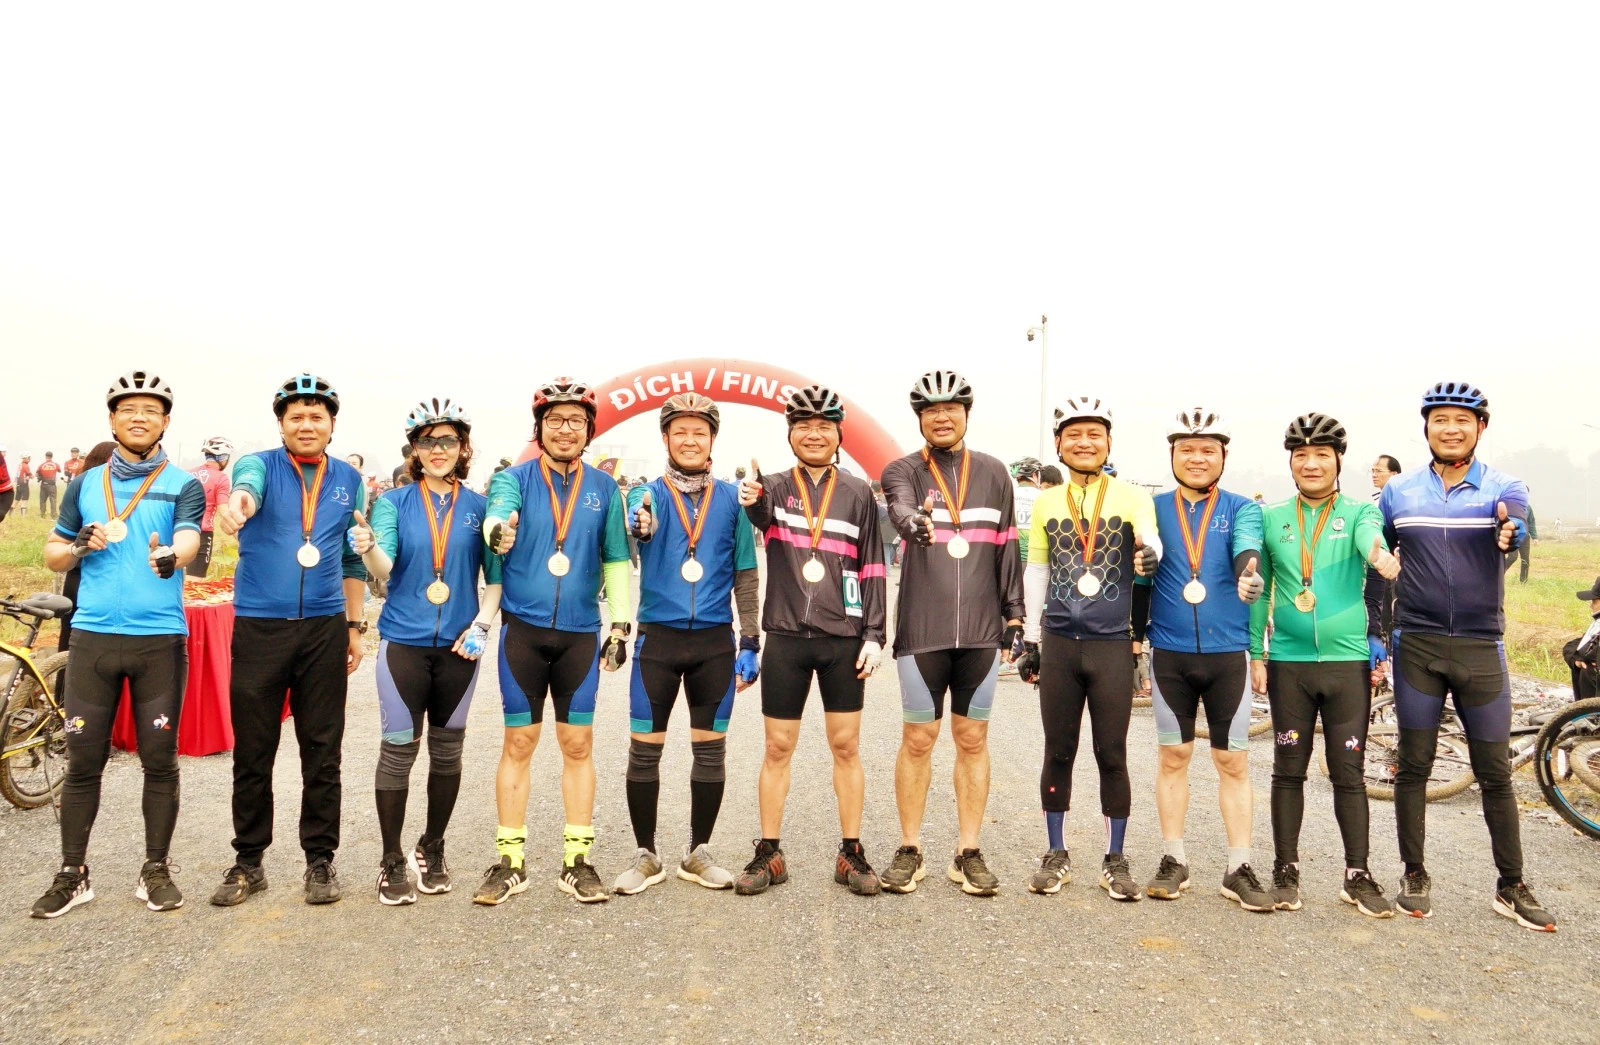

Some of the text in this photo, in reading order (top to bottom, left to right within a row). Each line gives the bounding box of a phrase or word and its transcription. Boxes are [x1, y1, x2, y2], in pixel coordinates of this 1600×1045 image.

[608, 371, 695, 411] ĐÍCH
[703, 367, 716, 390] /
[846, 577, 862, 605] 0
